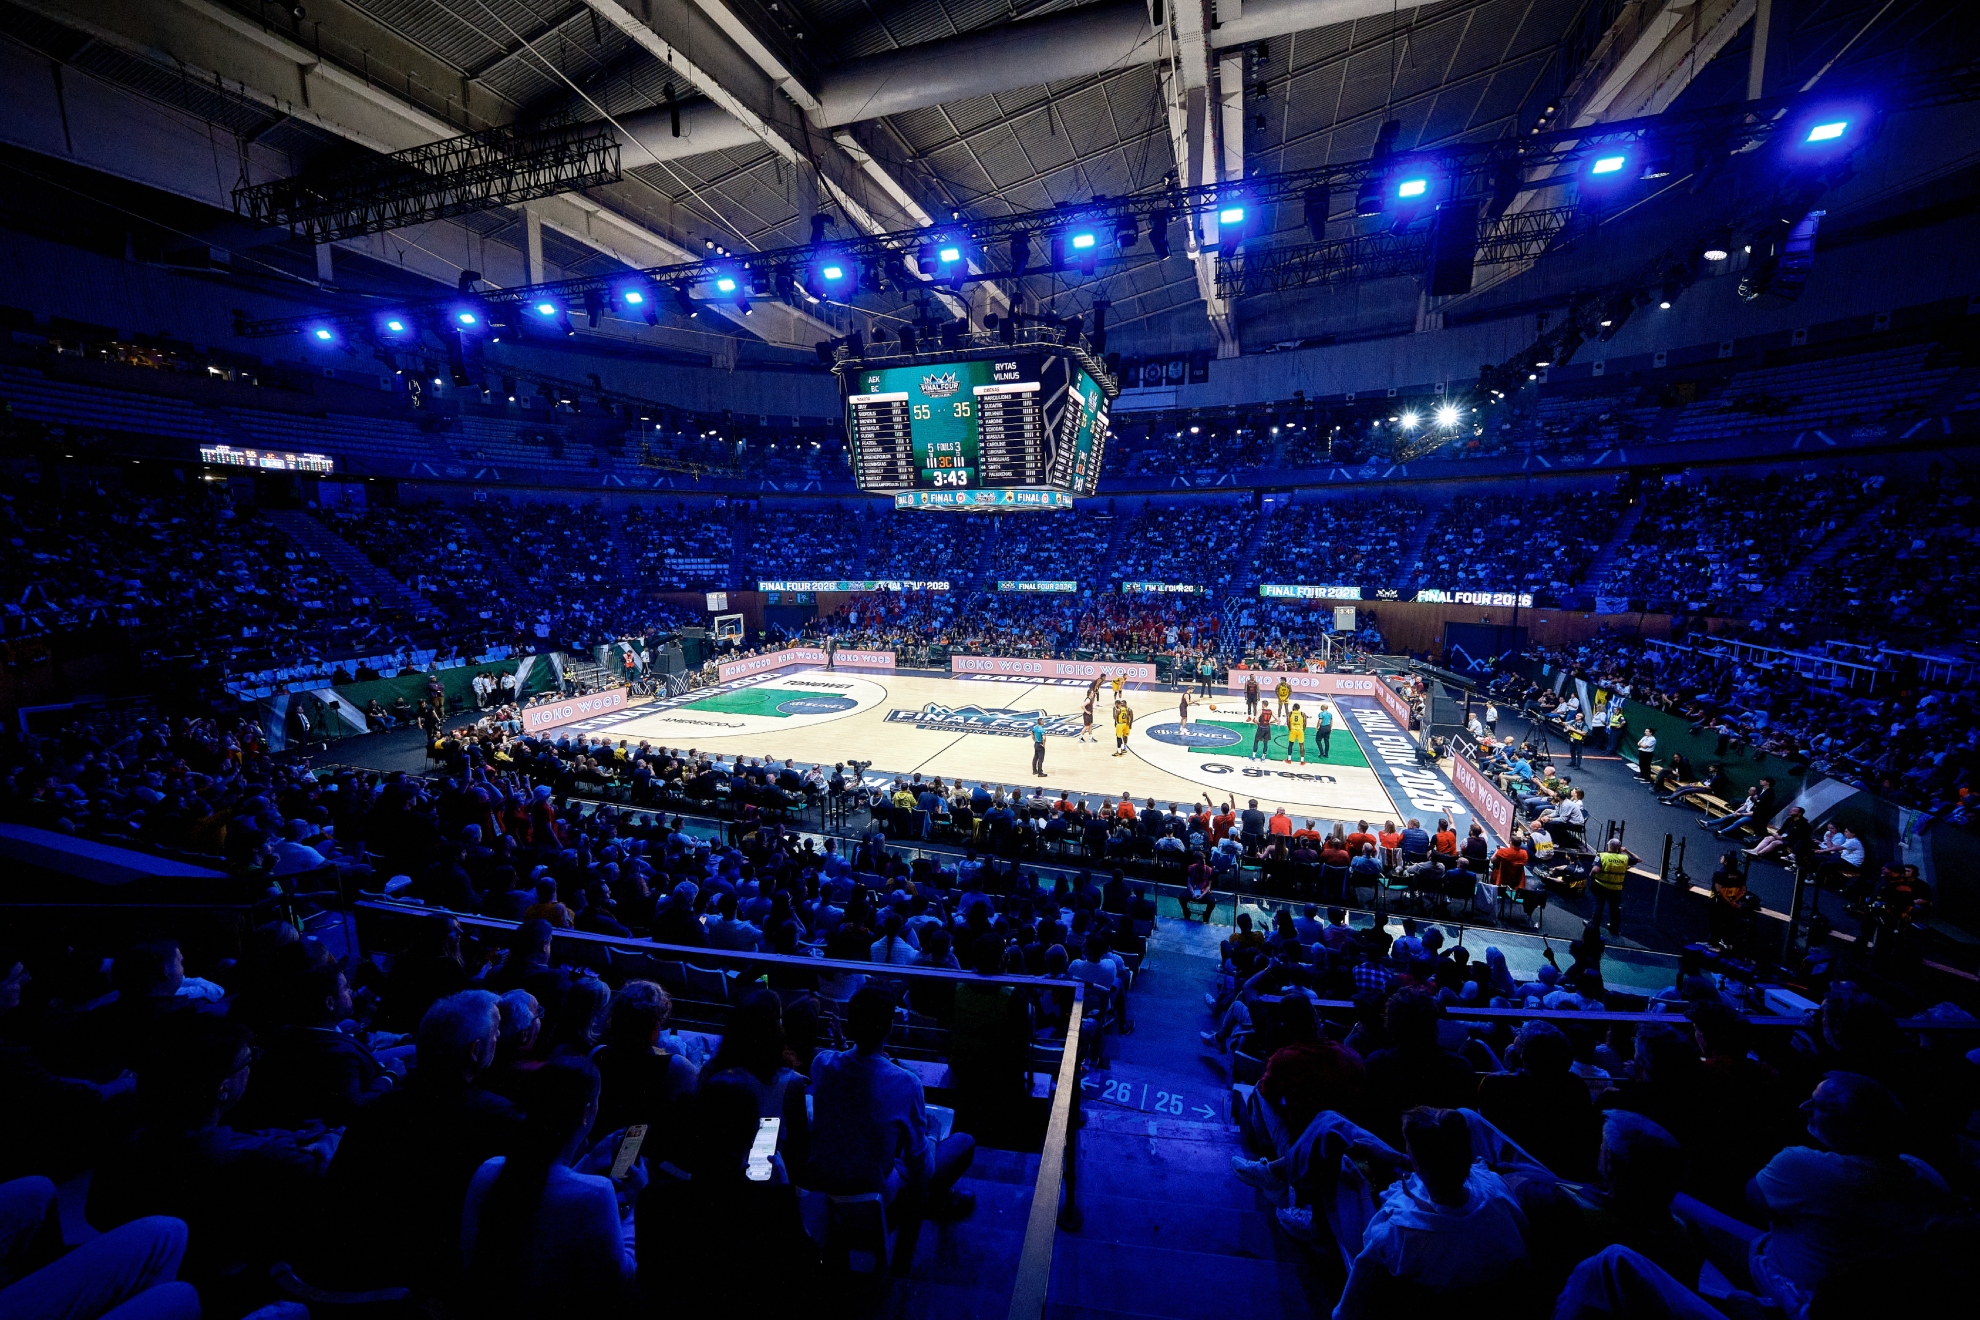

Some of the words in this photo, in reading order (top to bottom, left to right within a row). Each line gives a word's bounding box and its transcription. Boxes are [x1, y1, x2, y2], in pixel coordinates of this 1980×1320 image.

[995, 362, 1016, 371] RYTAS
[994, 372, 1020, 380] VILNIUS
[914, 405, 930, 420] 55
[954, 402, 970, 417] 35
[928, 443, 934, 452] 5
[937, 443, 953, 451] FOULS
[955, 442, 961, 451] 3
[939, 456, 952, 467] 3C
[934, 470, 967, 486] 3:43
[931, 494, 953, 502] FINAL
[1018, 494, 1040, 502] FINAL
[760, 583, 786, 591] FINAL
[1267, 586, 1295, 596] FINAL
[1328, 588, 1357, 597] 2026
[1418, 591, 1453, 602] FINAL
[1455, 592, 1491, 605] FOUR
[778, 652, 794, 663] KOKO
[796, 651, 824, 661] WOOD
[834, 653, 858, 662] KOKO
[861, 655, 890, 664] WOOD
[726, 664, 746, 676] KOKO
[748, 659, 770, 670] WOOD
[958, 659, 993, 670] KOKO
[998, 661, 1042, 673] WOOD
[1056, 664, 1095, 675] KOKO
[1100, 666, 1148, 678] WOOD
[1336, 680, 1372, 689] KOKO
[531, 706, 572, 725] KOKO
[577, 694, 620, 713] WOOD
[566, 706, 668, 730] FINAL
[896, 711, 981, 725] FINAL
[990, 718, 1085, 733] FOUR
[1351, 708, 1400, 733] FINAL
[924, 725, 989, 735] BADALONA
[1368, 734, 1421, 767] FOUR
[1242, 768, 1337, 782] green
[1389, 767, 1466, 815] 2026
[1456, 762, 1476, 793] KOKO
[1478, 782, 1507, 825] WOOD
[1102, 1080, 1131, 1103] 26
[1155, 1091, 1184, 1115] 25
